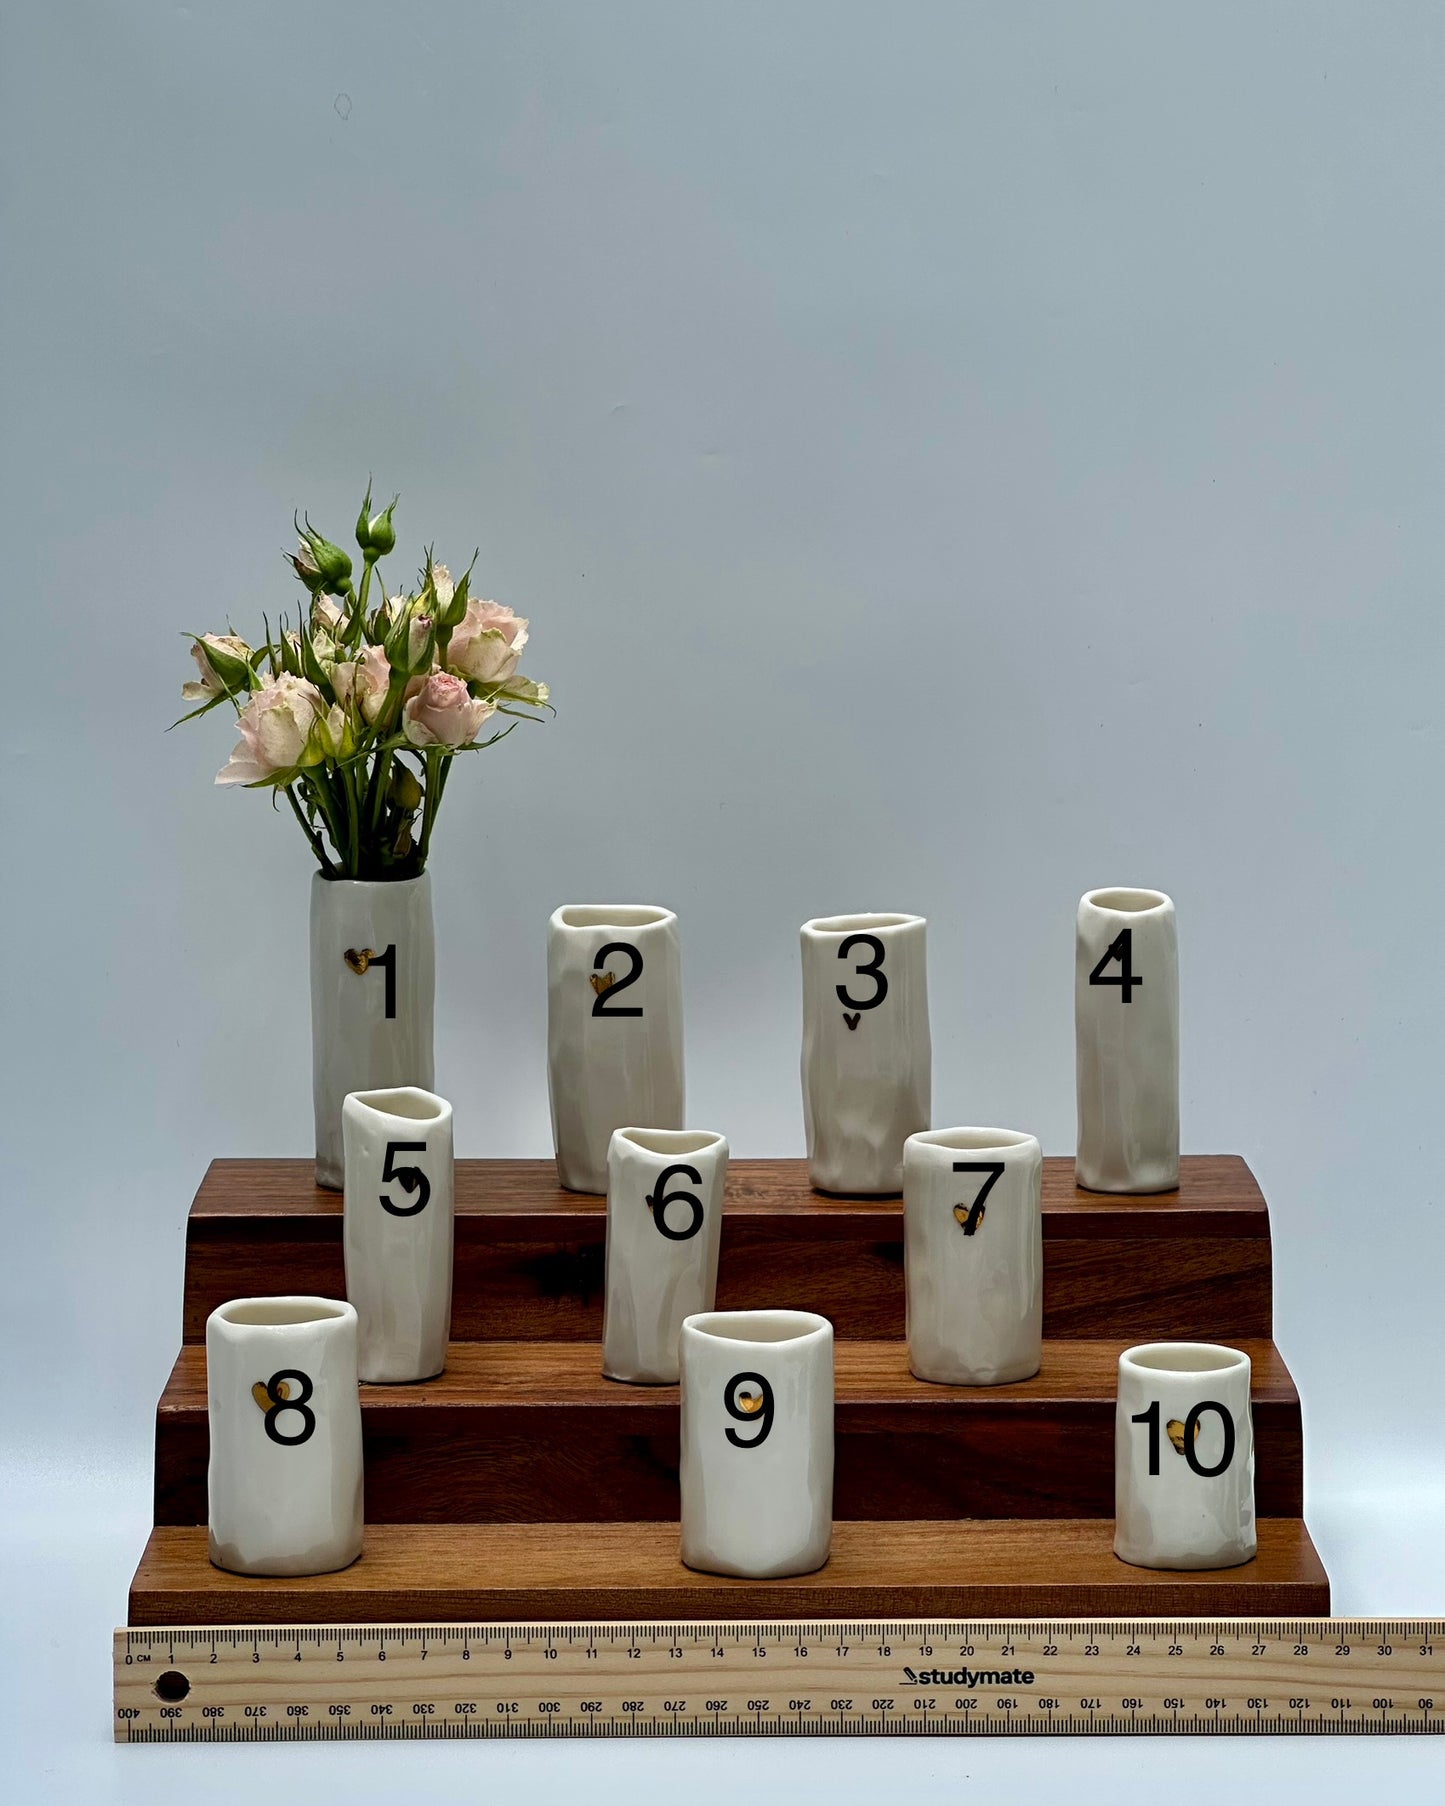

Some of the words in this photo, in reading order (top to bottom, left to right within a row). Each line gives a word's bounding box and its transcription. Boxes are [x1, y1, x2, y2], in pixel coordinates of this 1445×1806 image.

[125, 1655, 133, 1665] 0
[137, 1655, 151, 1664] CM
[167, 1654, 174, 1664] 1
[210, 1654, 217, 1663] 2
[252, 1653, 260, 1663] 3
[294, 1653, 301, 1662] 4
[337, 1652, 344, 1662] 5
[378, 1651, 386, 1661] 6
[421, 1651, 427, 1660] 7
[463, 1650, 470, 1660] 8
[504, 1650, 512, 1659] 9
[544, 1649, 557, 1659] 10
[586, 1649, 597, 1658] 11
[627, 1648, 640, 1658] 12
[669, 1648, 682, 1658] 13
[711, 1648, 724, 1657] 14
[753, 1648, 766, 1657] 15
[794, 1647, 807, 1657] 16
[836, 1647, 849, 1656] 17
[878, 1647, 890, 1656] 18
[919, 1646, 932, 1656] 19
[960, 1646, 974, 1656] 20
[1002, 1646, 1014, 1655] 21
[1043, 1646, 1057, 1655] 22
[1085, 1646, 1099, 1655] 23
[1127, 1646, 1140, 1655] 24
[1168, 1646, 1182, 1655] 25
[1210, 1645, 1224, 1655] 26
[1252, 1645, 1266, 1655] 27
[1294, 1645, 1308, 1655] 28
[1335, 1645, 1350, 1655] 29
[1377, 1645, 1392, 1655] 30
[1420, 1645, 1432, 1655] 31
[919, 1667, 1034, 1688] studymate
[455, 1703, 476, 1713] 320
[497, 1703, 518, 1713] 310
[539, 1702, 560, 1712] 300
[581, 1702, 602, 1712] 290
[622, 1702, 644, 1711] 280
[664, 1701, 685, 1711] 270
[706, 1701, 727, 1711] 260
[748, 1700, 769, 1710] 250
[789, 1700, 810, 1710] 240
[831, 1700, 852, 1710] 230
[872, 1700, 894, 1709] 220
[914, 1699, 935, 1709] 210
[956, 1699, 977, 1709] 200
[997, 1699, 1018, 1709] 190
[1039, 1699, 1059, 1709] 180
[1081, 1699, 1101, 1708] 170
[1122, 1699, 1143, 1708] 160
[1164, 1698, 1184, 1708] 150
[1206, 1698, 1226, 1708] 140
[1247, 1698, 1268, 1708] 130
[1289, 1698, 1310, 1708] 120
[1331, 1698, 1351, 1708] 110
[1373, 1699, 1394, 1708] 100
[1418, 1699, 1433, 1709] 90
[118, 1708, 140, 1719] 400
[160, 1707, 182, 1718] 390
[202, 1706, 224, 1717] 380
[244, 1706, 266, 1717] 370
[287, 1706, 308, 1716] 360
[329, 1705, 351, 1715] 350
[371, 1705, 392, 1715] 340
[413, 1704, 434, 1714] 330
